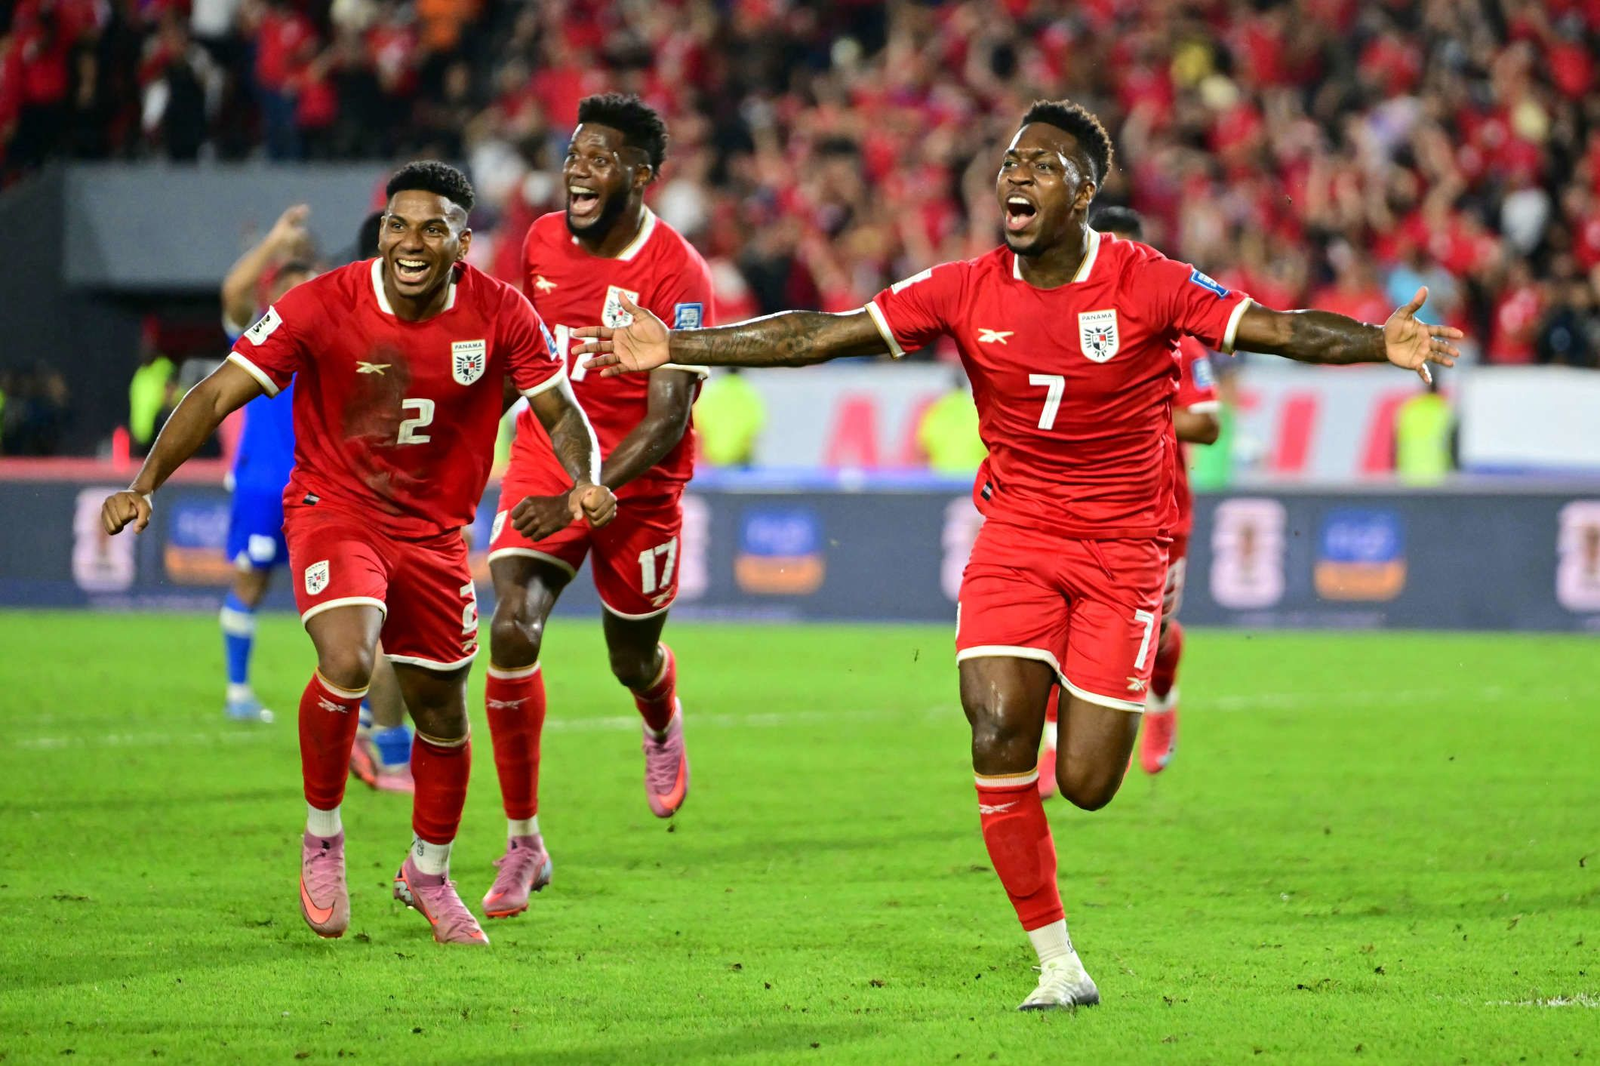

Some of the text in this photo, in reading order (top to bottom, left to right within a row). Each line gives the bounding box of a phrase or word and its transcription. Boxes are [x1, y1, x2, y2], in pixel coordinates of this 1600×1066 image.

[1081, 312, 1113, 321] PANAMA
[454, 342, 483, 350] PANAMA
[553, 323, 598, 381] 17
[397, 398, 435, 444] 2
[1028, 374, 1066, 430] 7
[638, 535, 677, 594] 17
[1134, 609, 1154, 670] 7
